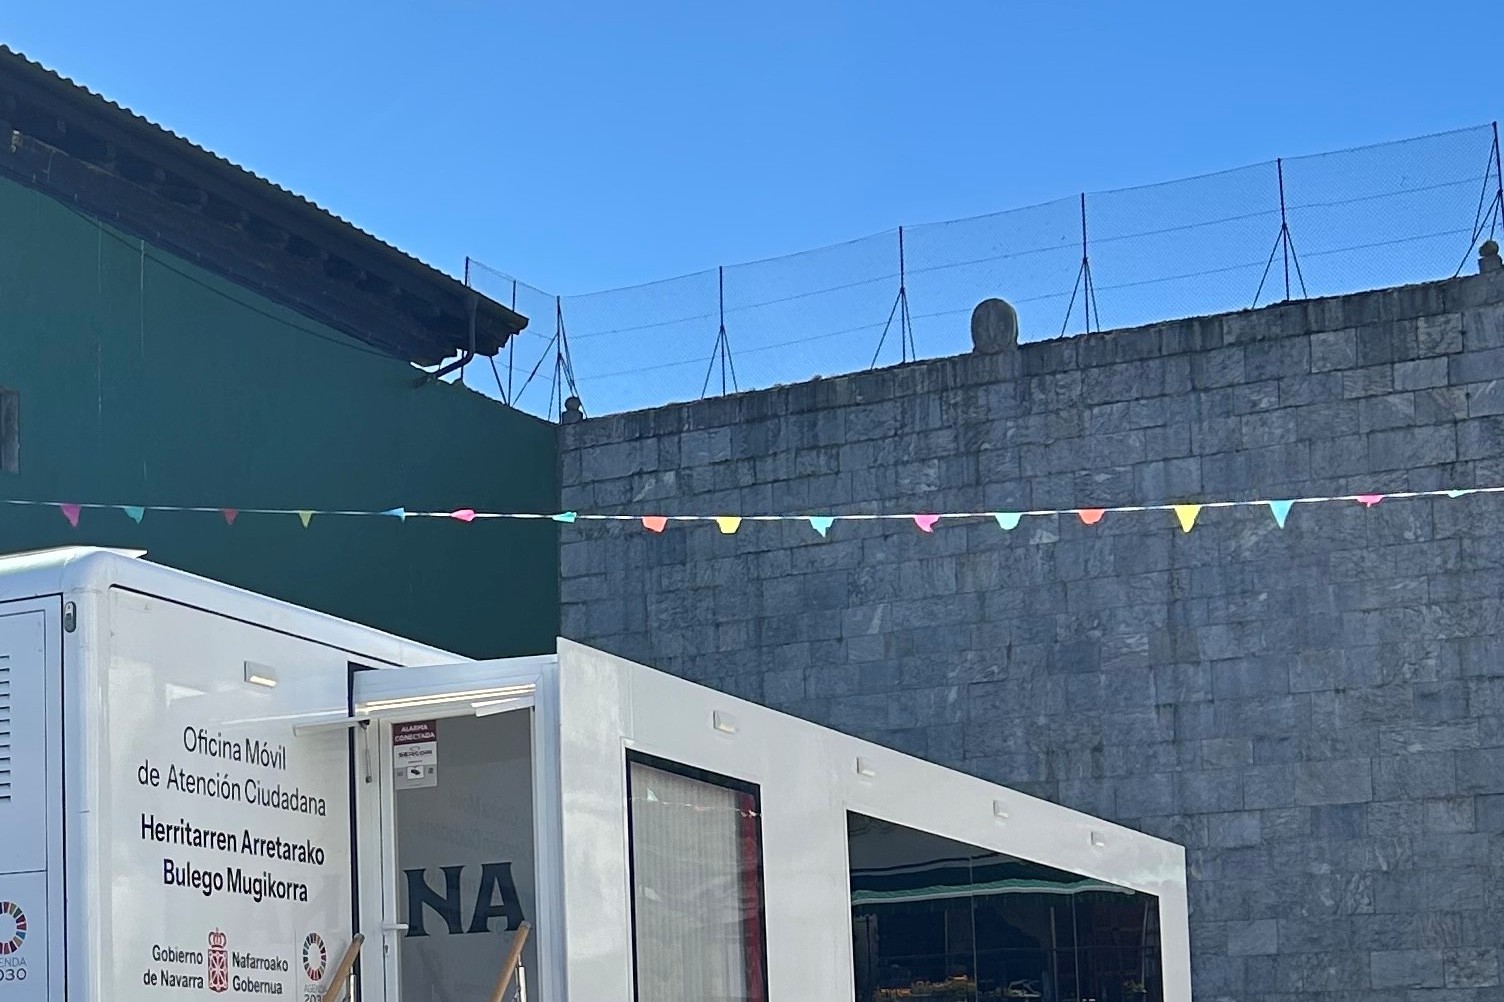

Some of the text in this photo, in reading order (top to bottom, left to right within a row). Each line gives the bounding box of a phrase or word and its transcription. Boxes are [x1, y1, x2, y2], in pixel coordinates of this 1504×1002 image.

[395, 732, 435, 742] CONECTADA
[401, 724, 428, 732] ALARMA
[184, 726, 286, 770] Oficina Móvil
[138, 759, 326, 816] de Atención Ciudadana
[141, 813, 325, 865] Herritarren Arretarako
[164, 858, 308, 902] Bulego Mugikorra
[402, 861, 529, 938] NA
[152, 944, 203, 964] Gobierno
[232, 952, 289, 972] Nafarroako
[143, 969, 204, 989] de Navarra
[232, 976, 283, 995] Gobernua
